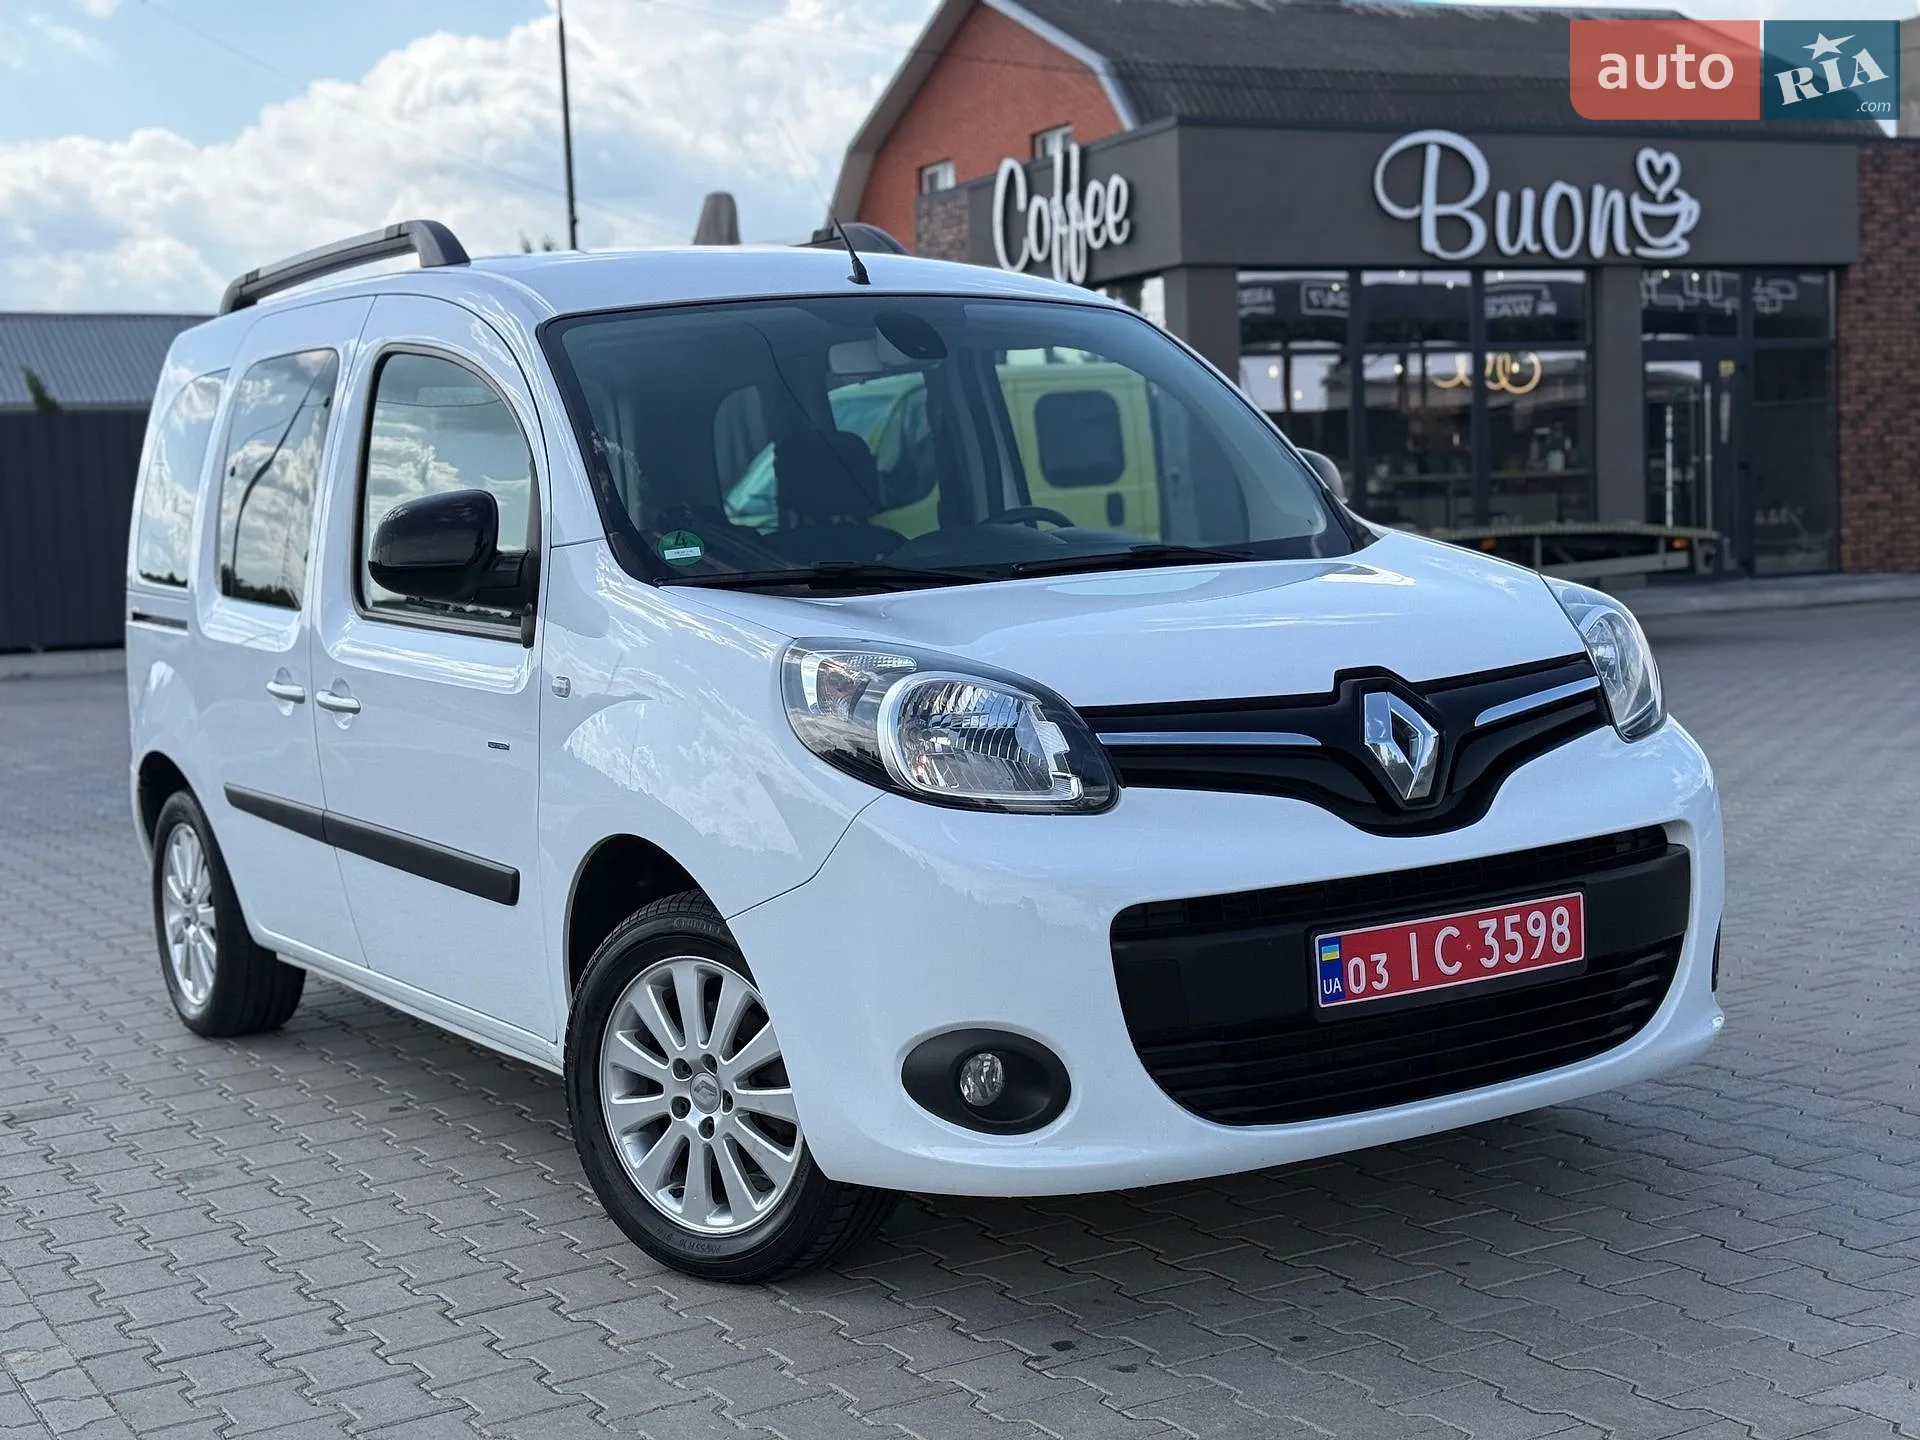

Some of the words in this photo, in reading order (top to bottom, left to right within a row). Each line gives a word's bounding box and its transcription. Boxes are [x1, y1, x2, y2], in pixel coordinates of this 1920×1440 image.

[992, 140, 1130, 284] Coffee
[1323, 979, 1342, 995] UA
[1347, 953, 1389, 995] 03
[1478, 906, 1571, 969] 3598
